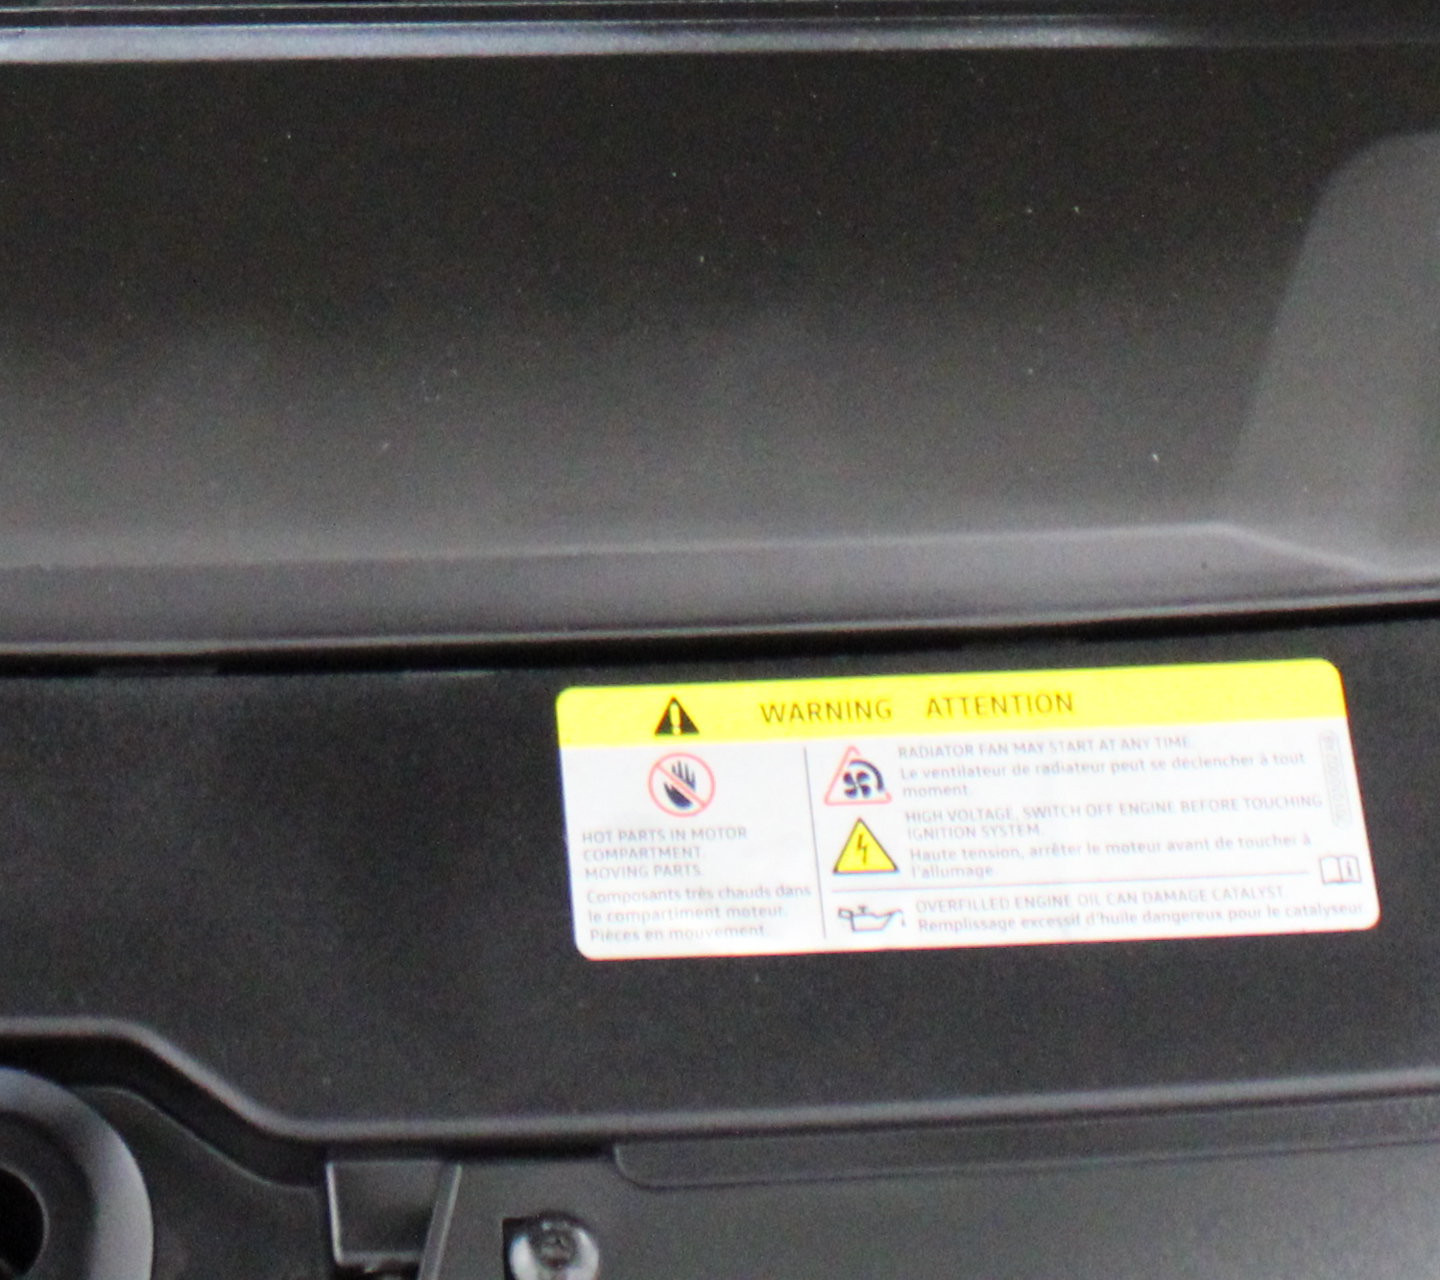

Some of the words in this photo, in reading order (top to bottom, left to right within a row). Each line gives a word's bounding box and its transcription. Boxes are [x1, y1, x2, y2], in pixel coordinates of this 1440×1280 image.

[760, 699, 893, 724] WARNING
[926, 692, 1075, 719] ATTENTION
[897, 744, 974, 759] RADIATOR
[978, 742, 1009, 757] FAN
[1012, 741, 1045, 755] MAY
[1048, 740, 1094, 753] START
[1099, 739, 1117, 753] AT
[1120, 736, 1150, 751] ANY
[900, 767, 919, 780] Le
[922, 764, 1007, 779] ventilateur
[1011, 763, 1032, 777] de
[1034, 760, 1106, 776] radiateur
[1111, 757, 1145, 776] peut
[1150, 759, 1167, 771] se
[1272, 751, 1306, 766] tout
[904, 809, 943, 824] HIGH
[1022, 804, 1082, 820] SWITCH
[1085, 802, 1114, 818] OFF
[1119, 798, 1177, 816] ENGINE
[1179, 796, 1239, 814] BEFORE
[1243, 793, 1323, 810] TOUCHING
[582, 830, 613, 845] HOT
[618, 828, 665, 843] PARTS
[670, 828, 688, 841] IN
[691, 825, 747, 840] MOTOR
[906, 826, 977, 841] IGNITION
[910, 847, 957, 863] Haute
[1086, 841, 1101, 855] le
[1104, 839, 1161, 855] moteur
[1166, 838, 1210, 853] avant
[1215, 836, 1234, 851] de
[1237, 832, 1298, 850] toucher
[584, 865, 649, 881] MOVING
[586, 888, 682, 907] Composants
[718, 885, 771, 899] chauds
[775, 884, 812, 898] dans
[915, 896, 1010, 914] OVERFILLED
[1014, 893, 1072, 909] ENGINE
[1077, 891, 1101, 906] OIL
[1105, 890, 1139, 905] CAN
[1142, 888, 1208, 904] DAMAGE
[588, 909, 603, 923] le
[606, 907, 721, 924] compartiment
[918, 916, 1016, 934] Remplissage
[1019, 913, 1081, 929] excessif
[1142, 908, 1222, 926] dangereux
[1227, 906, 1262, 923] pour
[1266, 905, 1281, 918] le
[644, 927, 664, 941] en
